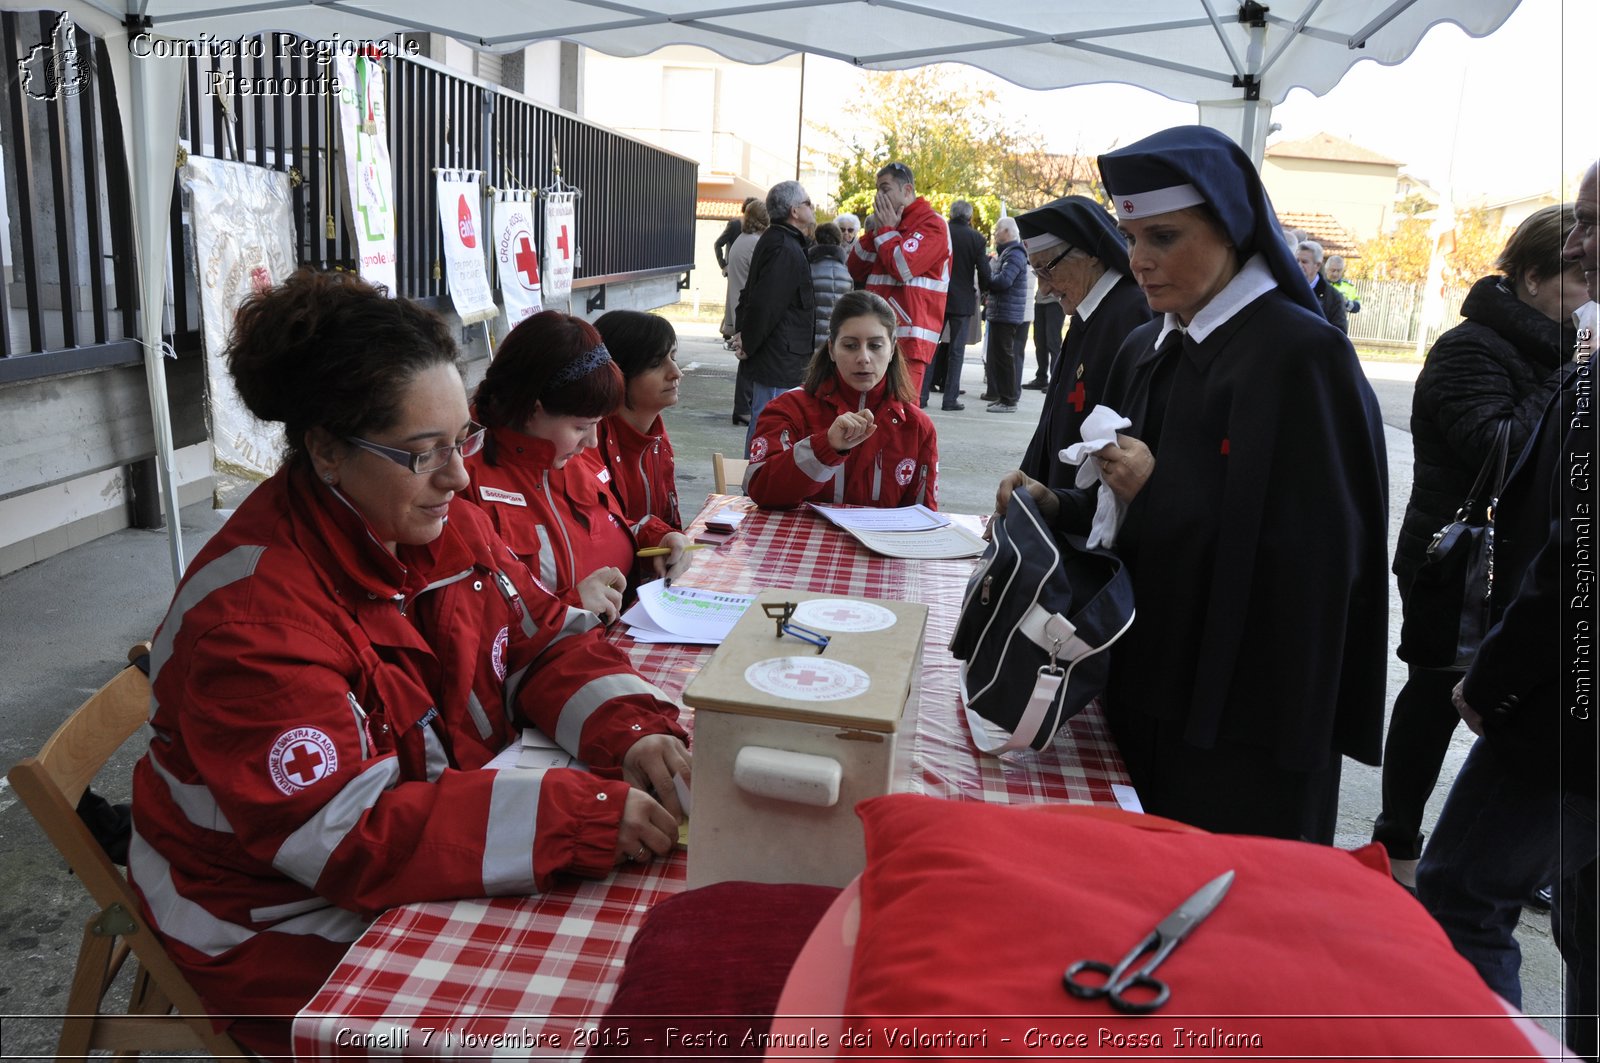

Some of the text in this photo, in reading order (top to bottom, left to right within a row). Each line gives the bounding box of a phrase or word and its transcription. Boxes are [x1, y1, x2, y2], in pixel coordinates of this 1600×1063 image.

[500, 225, 511, 263] CROCE
[272, 747, 280, 756] DI
[278, 730, 309, 748] GINEVRA
[311, 732, 322, 741] 22
[320, 738, 336, 773] AGOSTO
